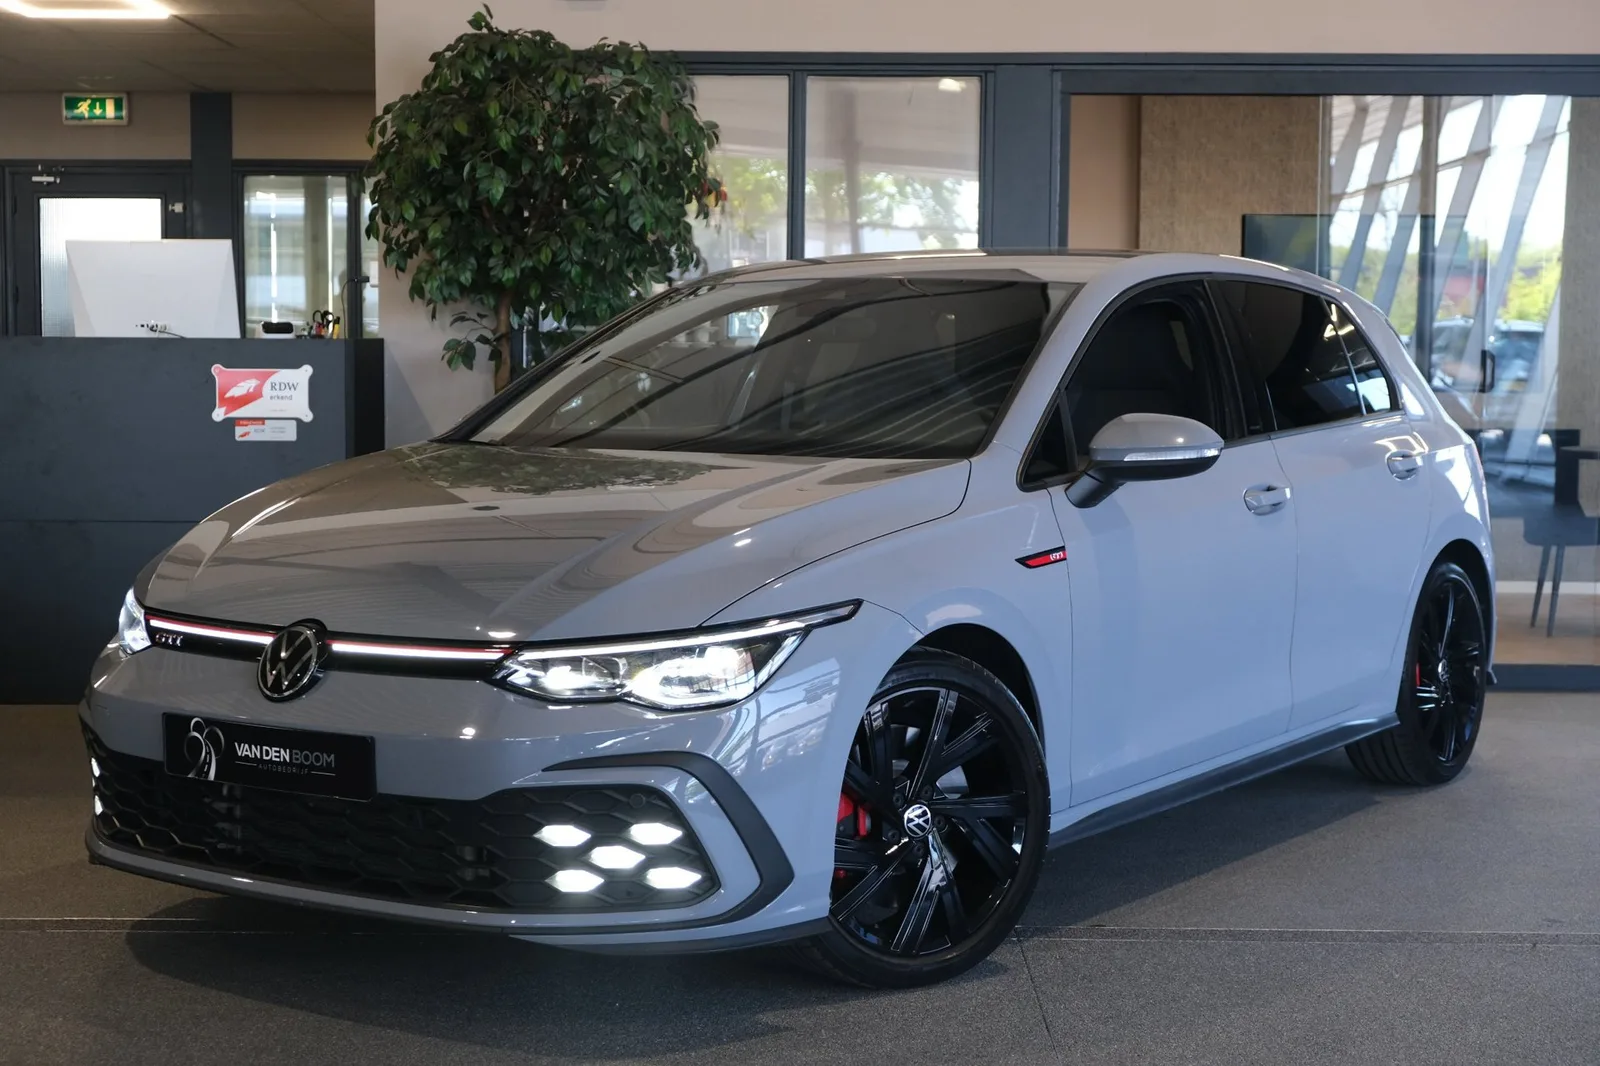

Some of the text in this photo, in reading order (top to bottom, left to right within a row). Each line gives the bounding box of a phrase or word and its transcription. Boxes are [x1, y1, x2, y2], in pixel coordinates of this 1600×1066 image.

[270, 382, 299, 392] RDW
[155, 632, 184, 647] GTI
[234, 742, 335, 768] VAN DEN BOOM
[258, 764, 309, 775] AUTOBEDRIJF
